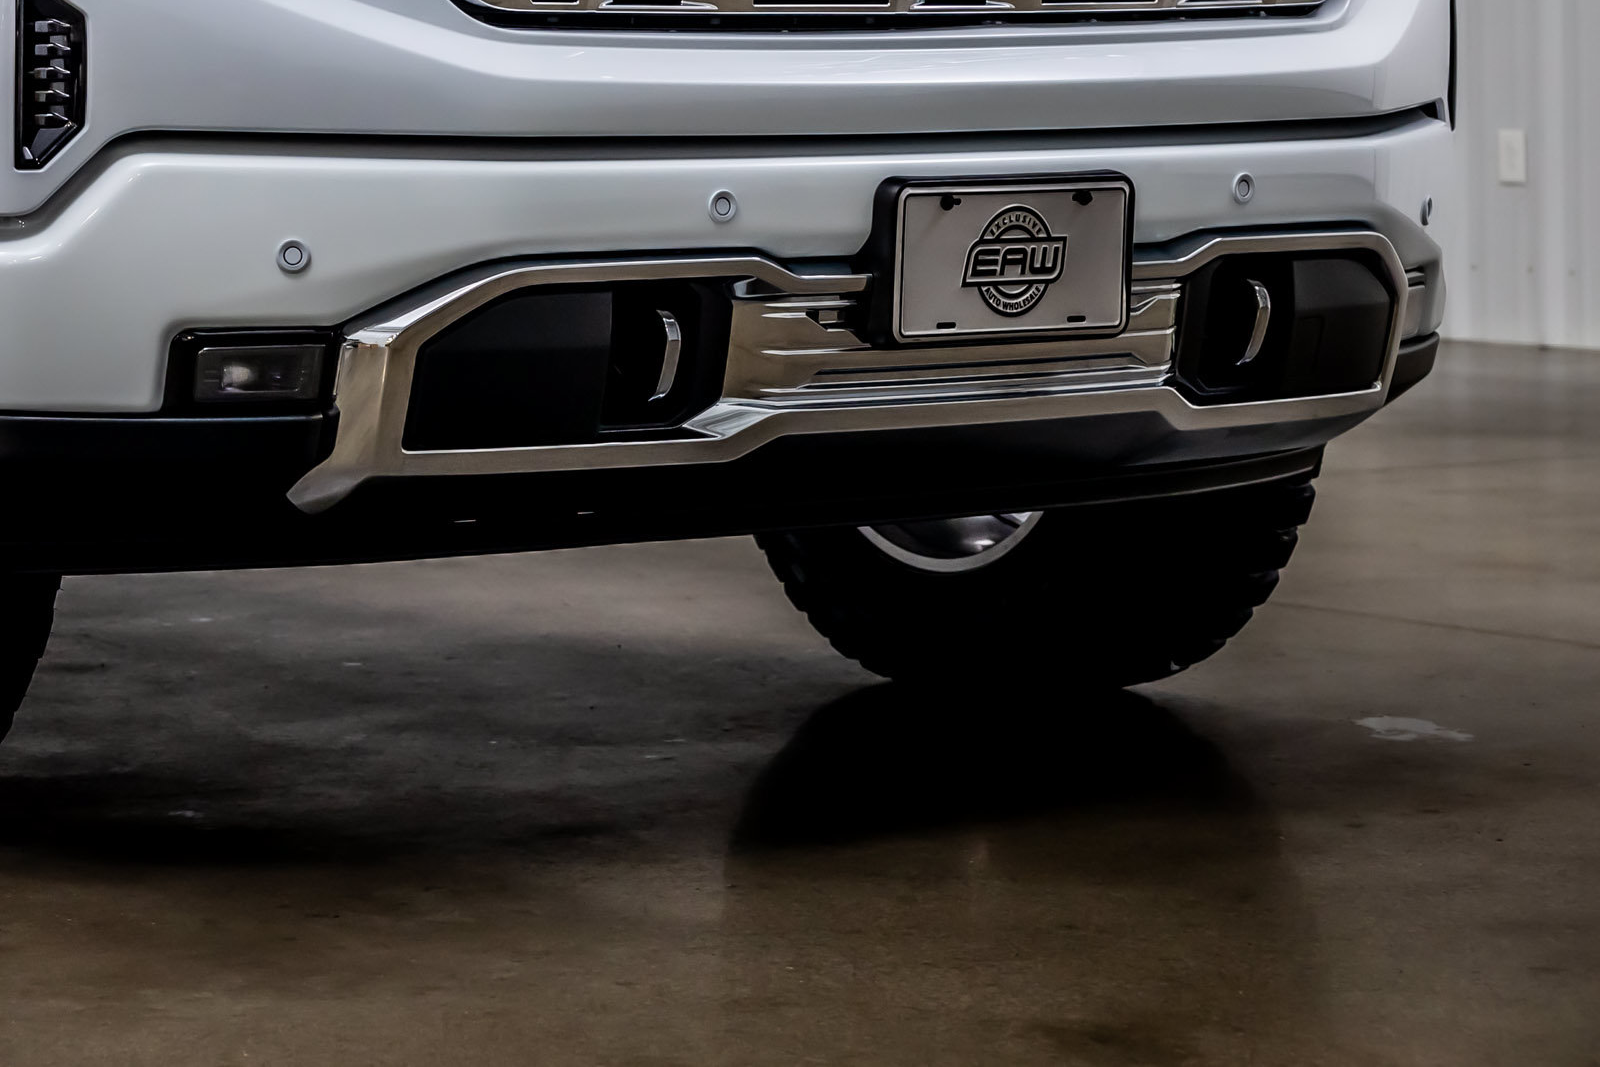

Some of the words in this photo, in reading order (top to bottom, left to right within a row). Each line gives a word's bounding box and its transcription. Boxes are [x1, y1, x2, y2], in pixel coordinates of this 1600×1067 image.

[990, 213, 1043, 236] EXCLUSIVE
[970, 246, 1060, 277] EAW
[984, 287, 1002, 307] AUTO
[1002, 286, 1041, 311] WHOLESALE
